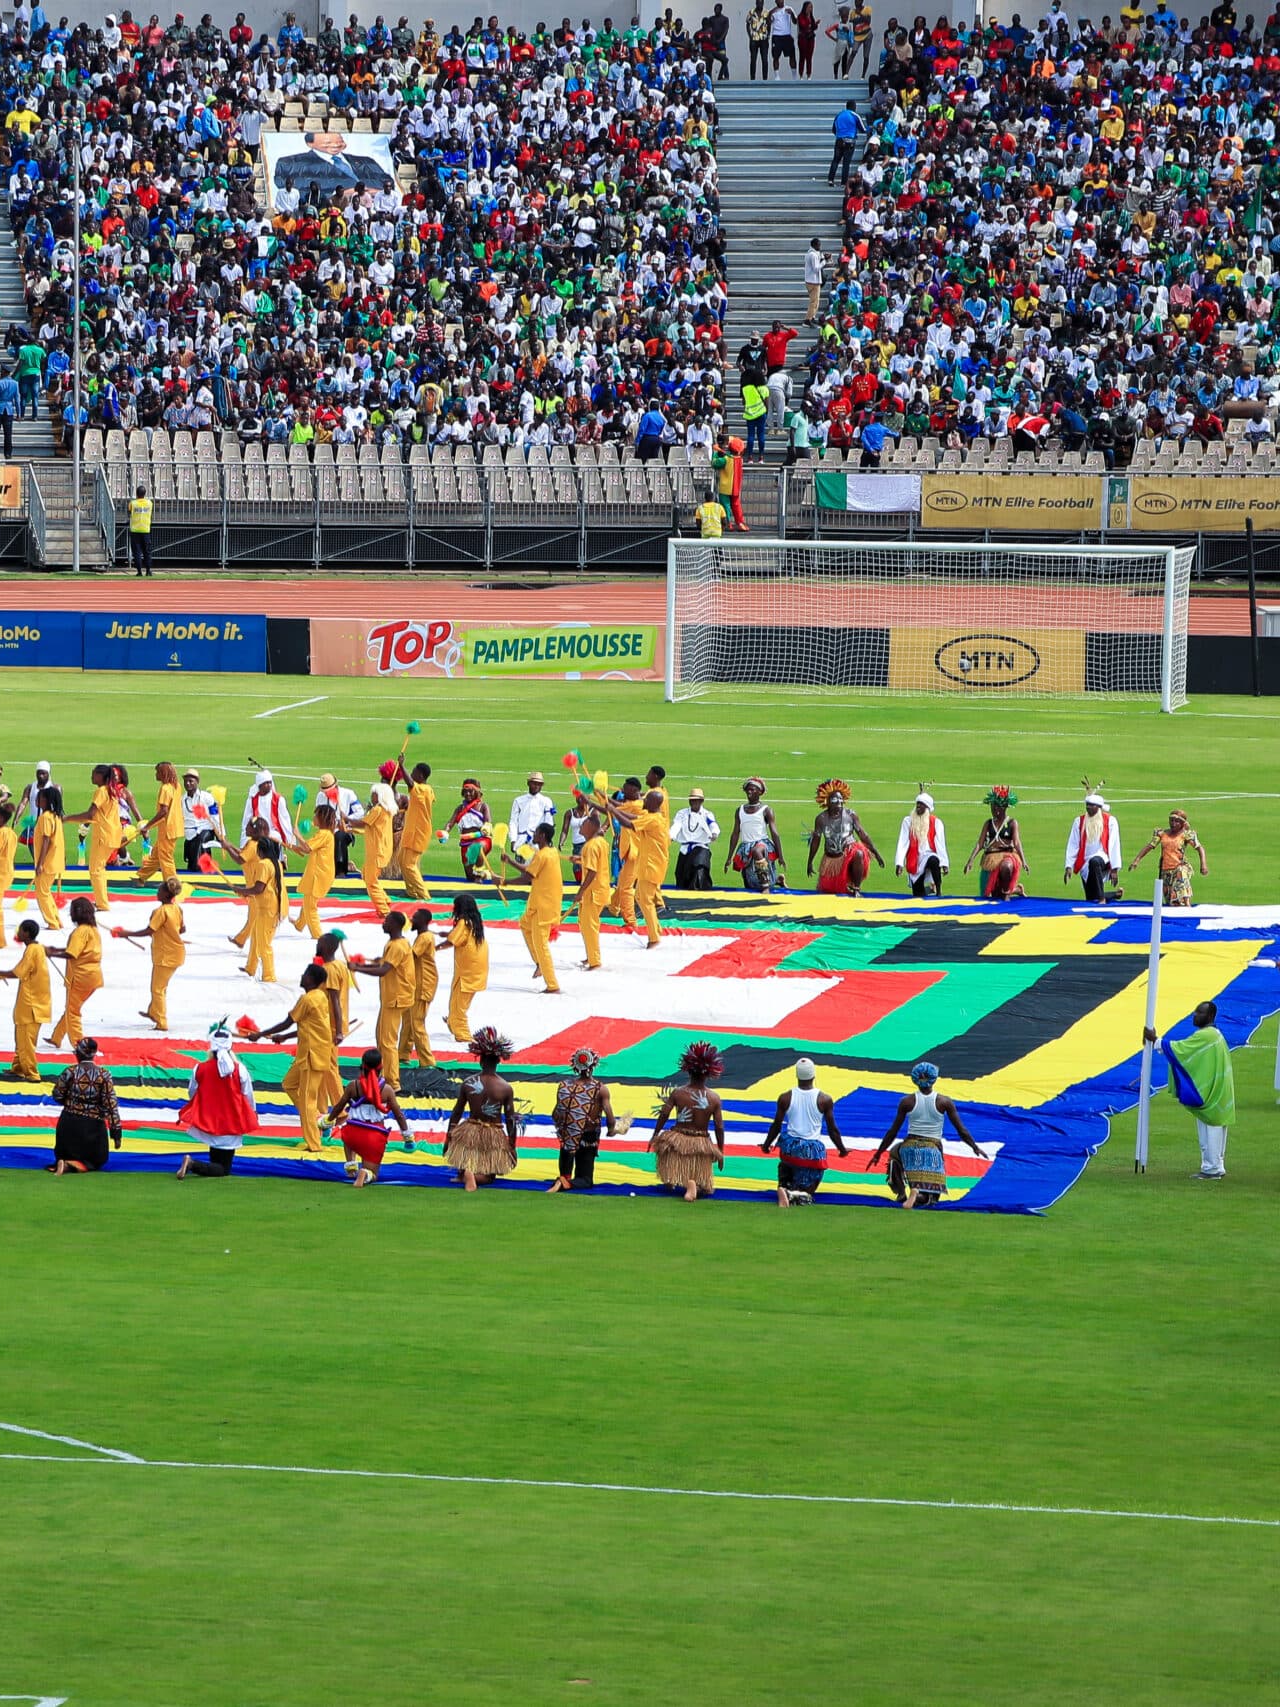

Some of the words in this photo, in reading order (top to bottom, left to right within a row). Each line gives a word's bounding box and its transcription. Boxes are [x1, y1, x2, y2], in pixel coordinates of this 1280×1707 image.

[935, 497, 958, 505] MTN
[972, 496, 1003, 508] MTN
[1005, 496, 1035, 508] Elite
[1038, 497, 1095, 509] Football
[1144, 500, 1168, 508] MTN
[1181, 499, 1212, 510] MTN
[1215, 499, 1245, 510] Elite
[105, 620, 153, 640] Just
[155, 621, 220, 641] MoMo
[223, 622, 244, 641] it.
[473, 633, 643, 665] PAMPLEMOUSSE
[960, 650, 1014, 671] MTN
